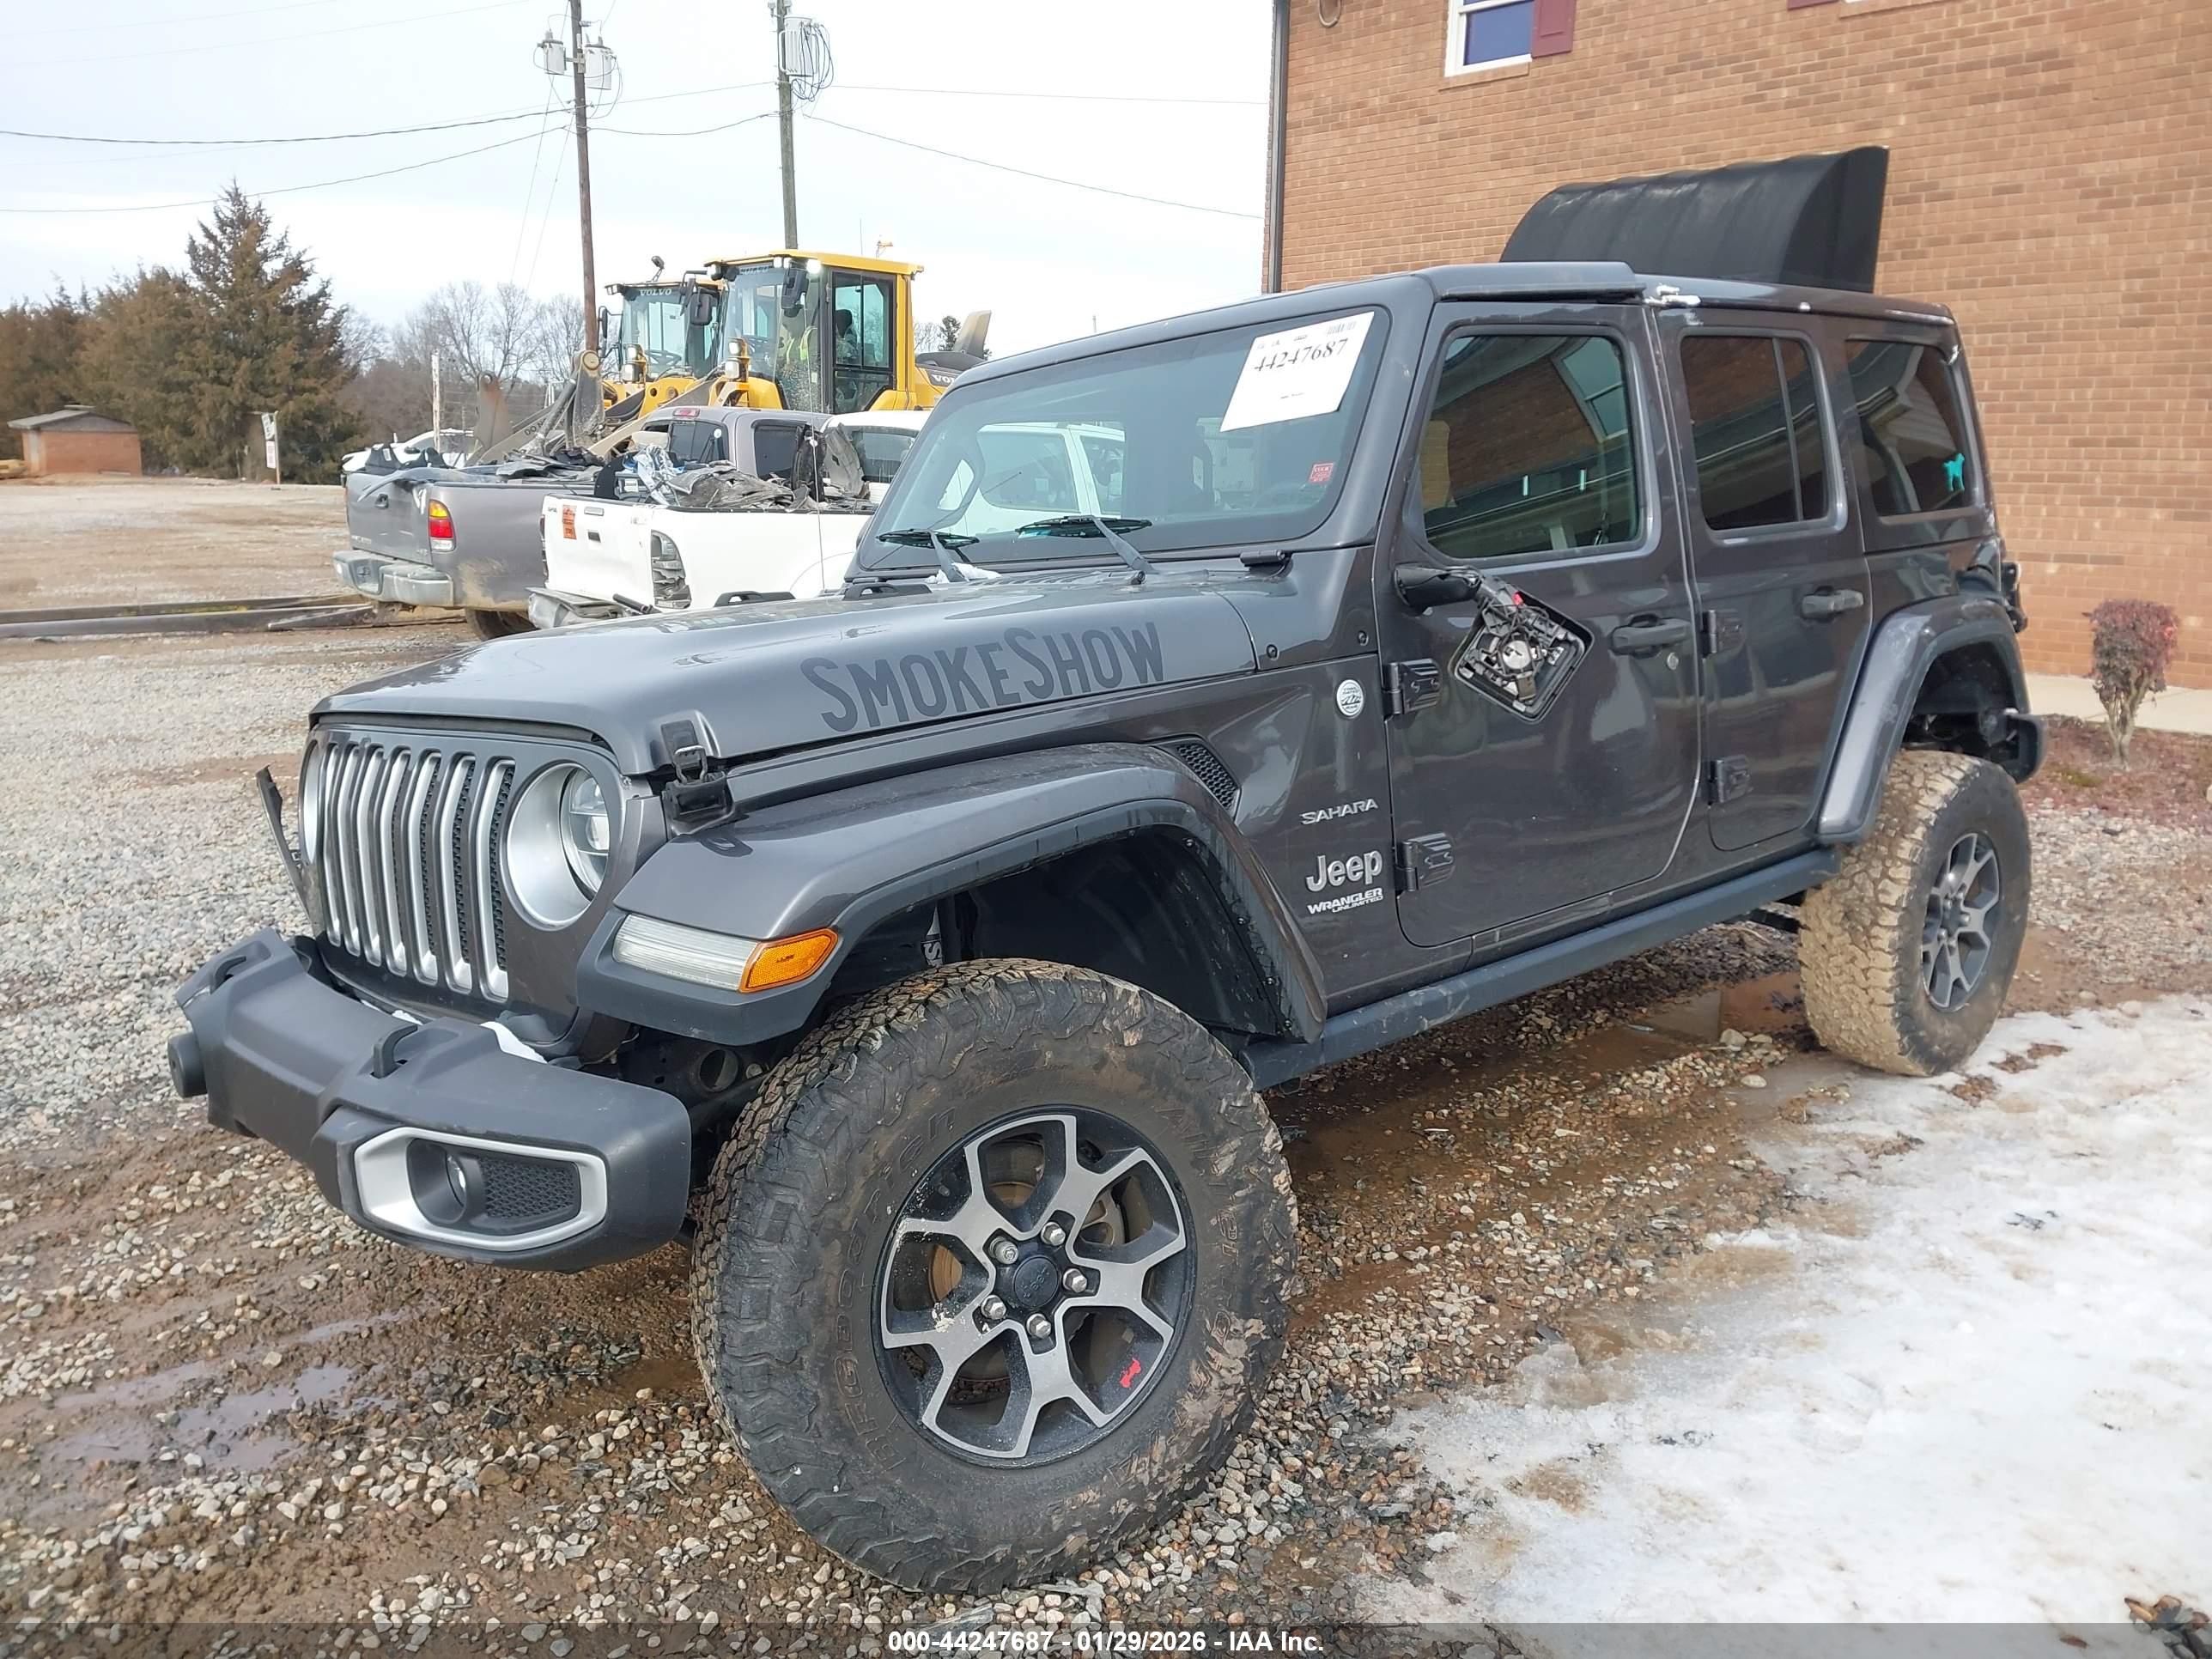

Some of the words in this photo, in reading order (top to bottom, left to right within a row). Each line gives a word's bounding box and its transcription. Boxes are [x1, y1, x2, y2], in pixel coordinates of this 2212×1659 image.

[640, 288, 672, 296] VOLVO
[1254, 337, 1349, 372] 44247687
[1299, 799, 1378, 825] SAHARA
[1305, 850, 1383, 892] Jeep
[1307, 887, 1383, 915] WRANGLER
[1332, 895, 1383, 913] UNLIMITED
